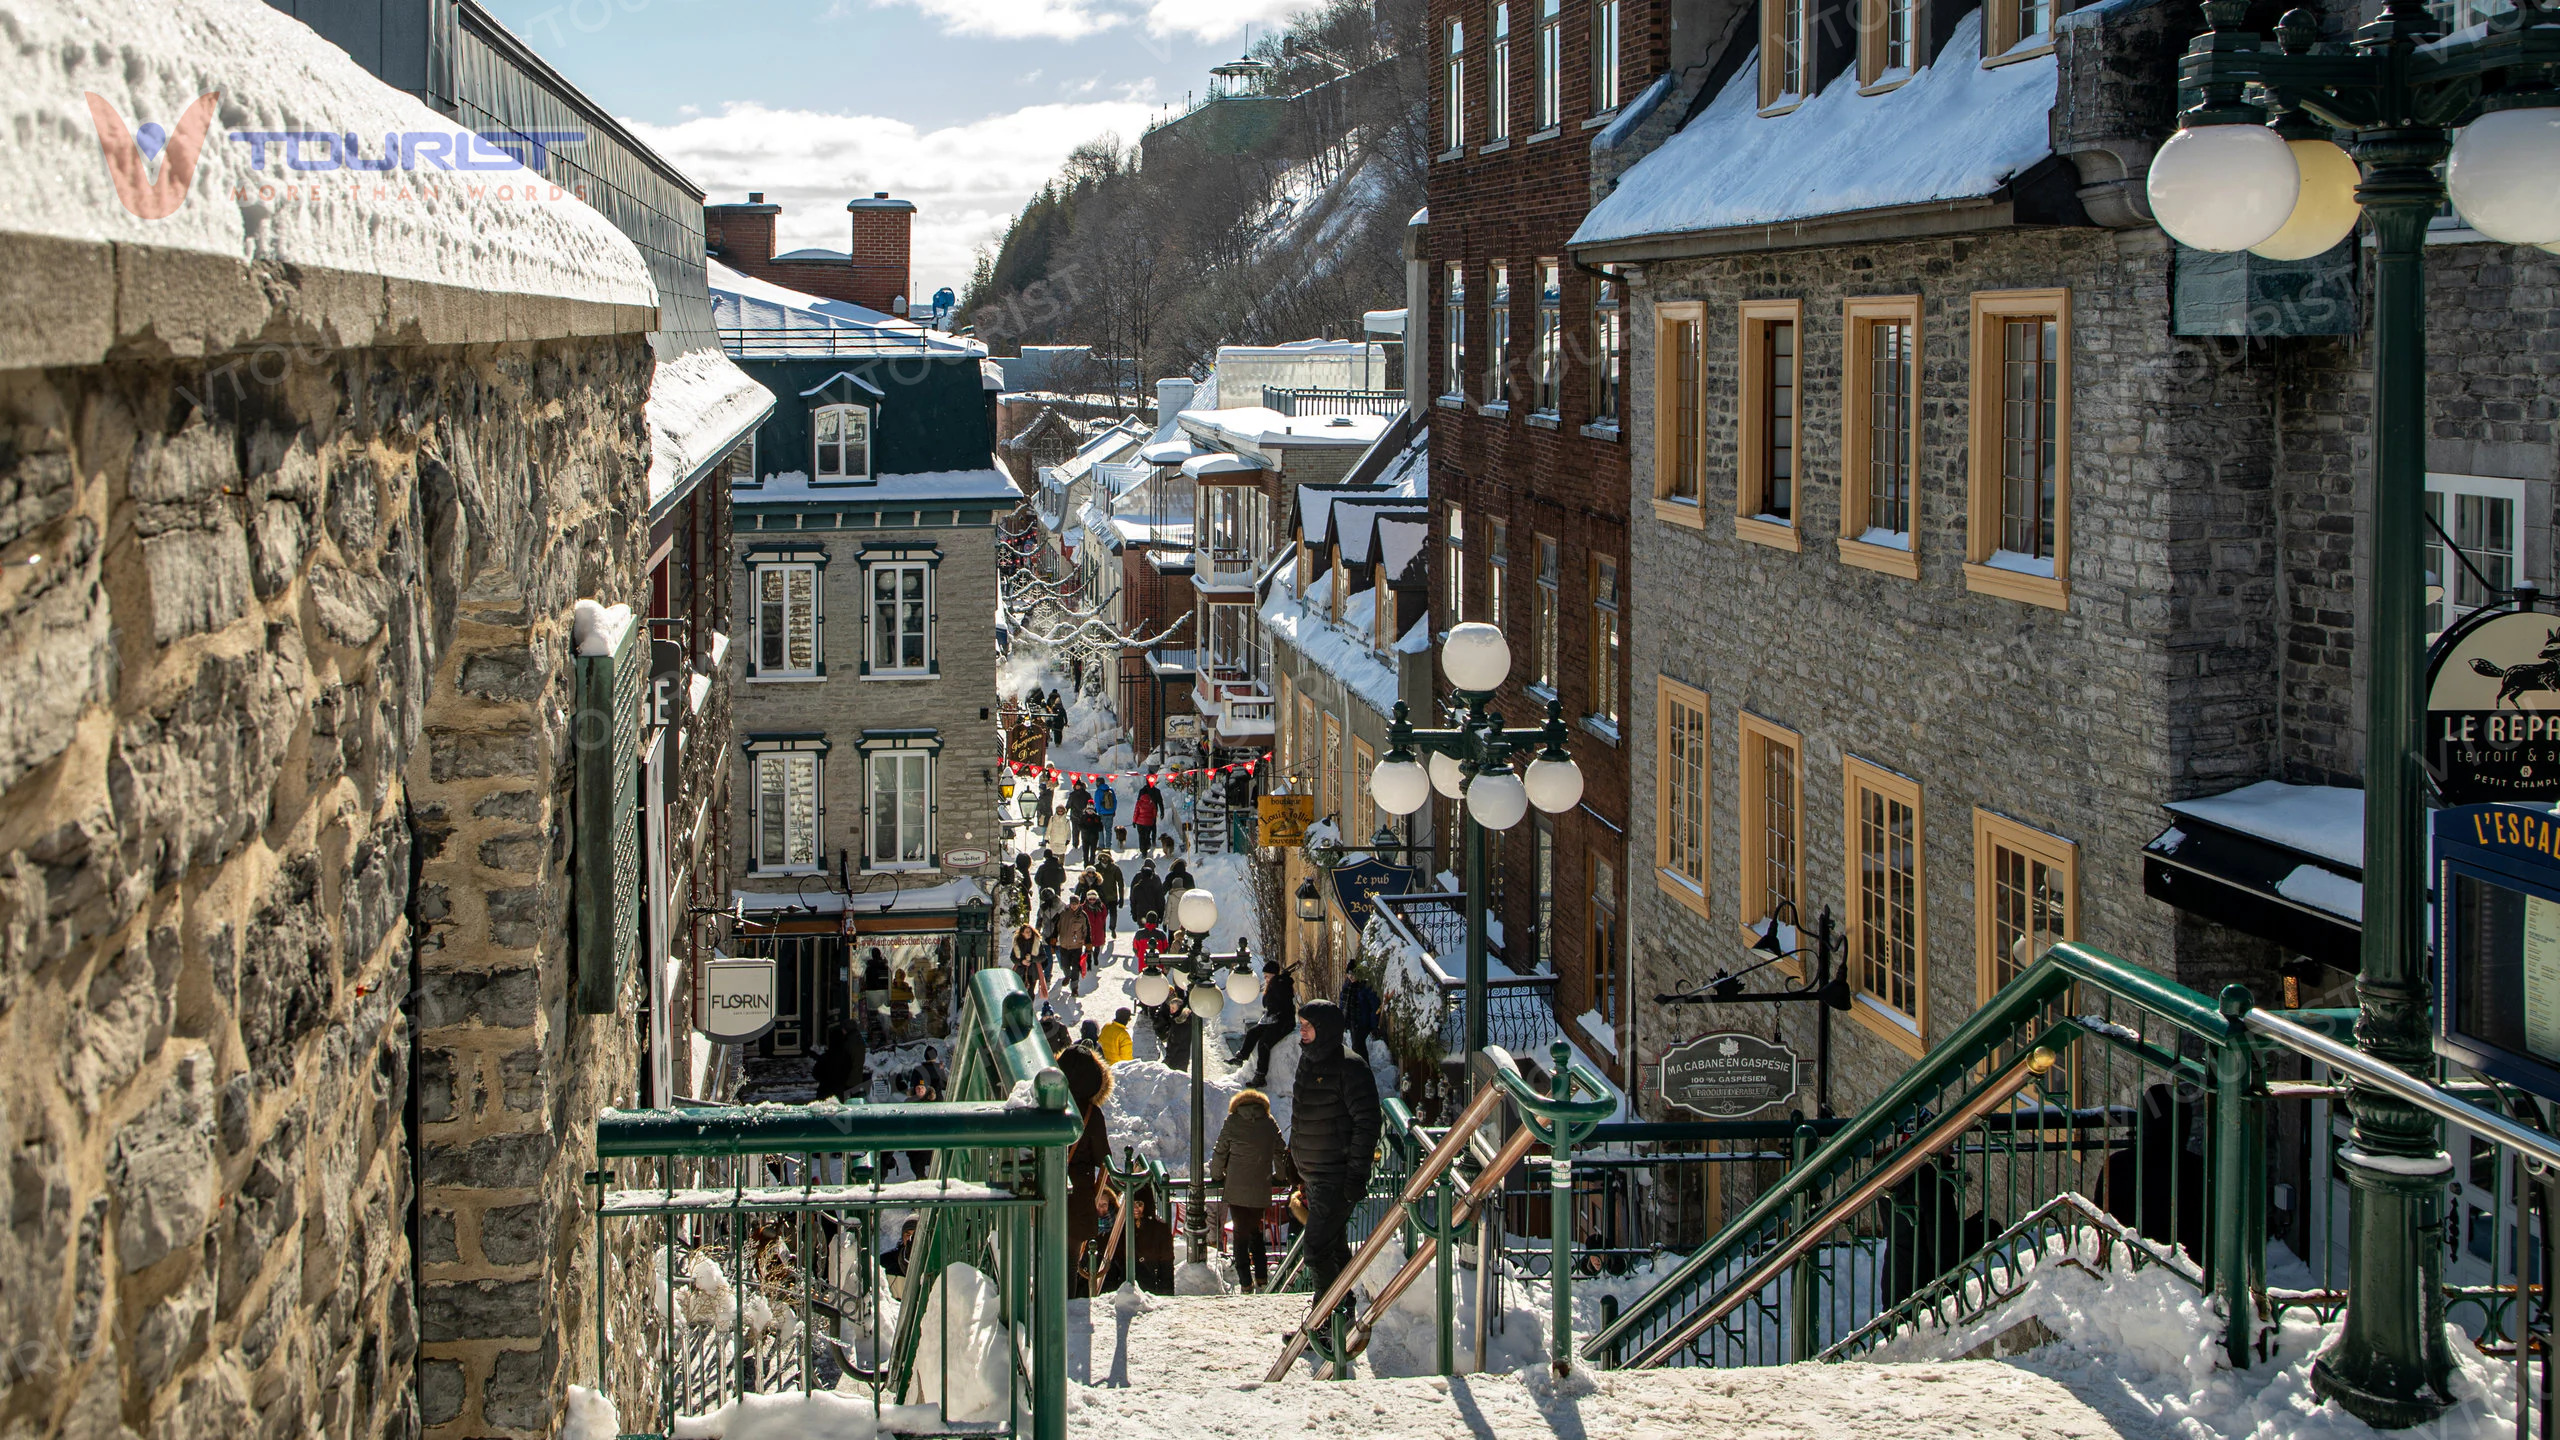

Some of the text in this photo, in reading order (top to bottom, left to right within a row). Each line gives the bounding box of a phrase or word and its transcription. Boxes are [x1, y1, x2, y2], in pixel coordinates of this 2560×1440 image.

[2444, 714, 2476, 742] LE
[2456, 747, 2518, 763] terroir
[2527, 747, 2537, 762] &
[2474, 773, 2508, 787] PETIT
[1353, 873, 1390, 887] Le pub
[711, 993, 769, 1009] FLORIN
[1667, 1065, 1683, 1076] MA
[1684, 1058, 1725, 1072] CABANE
[1726, 1058, 1739, 1068] EN
[1718, 1074, 1767, 1083] GASPÉSIEN
